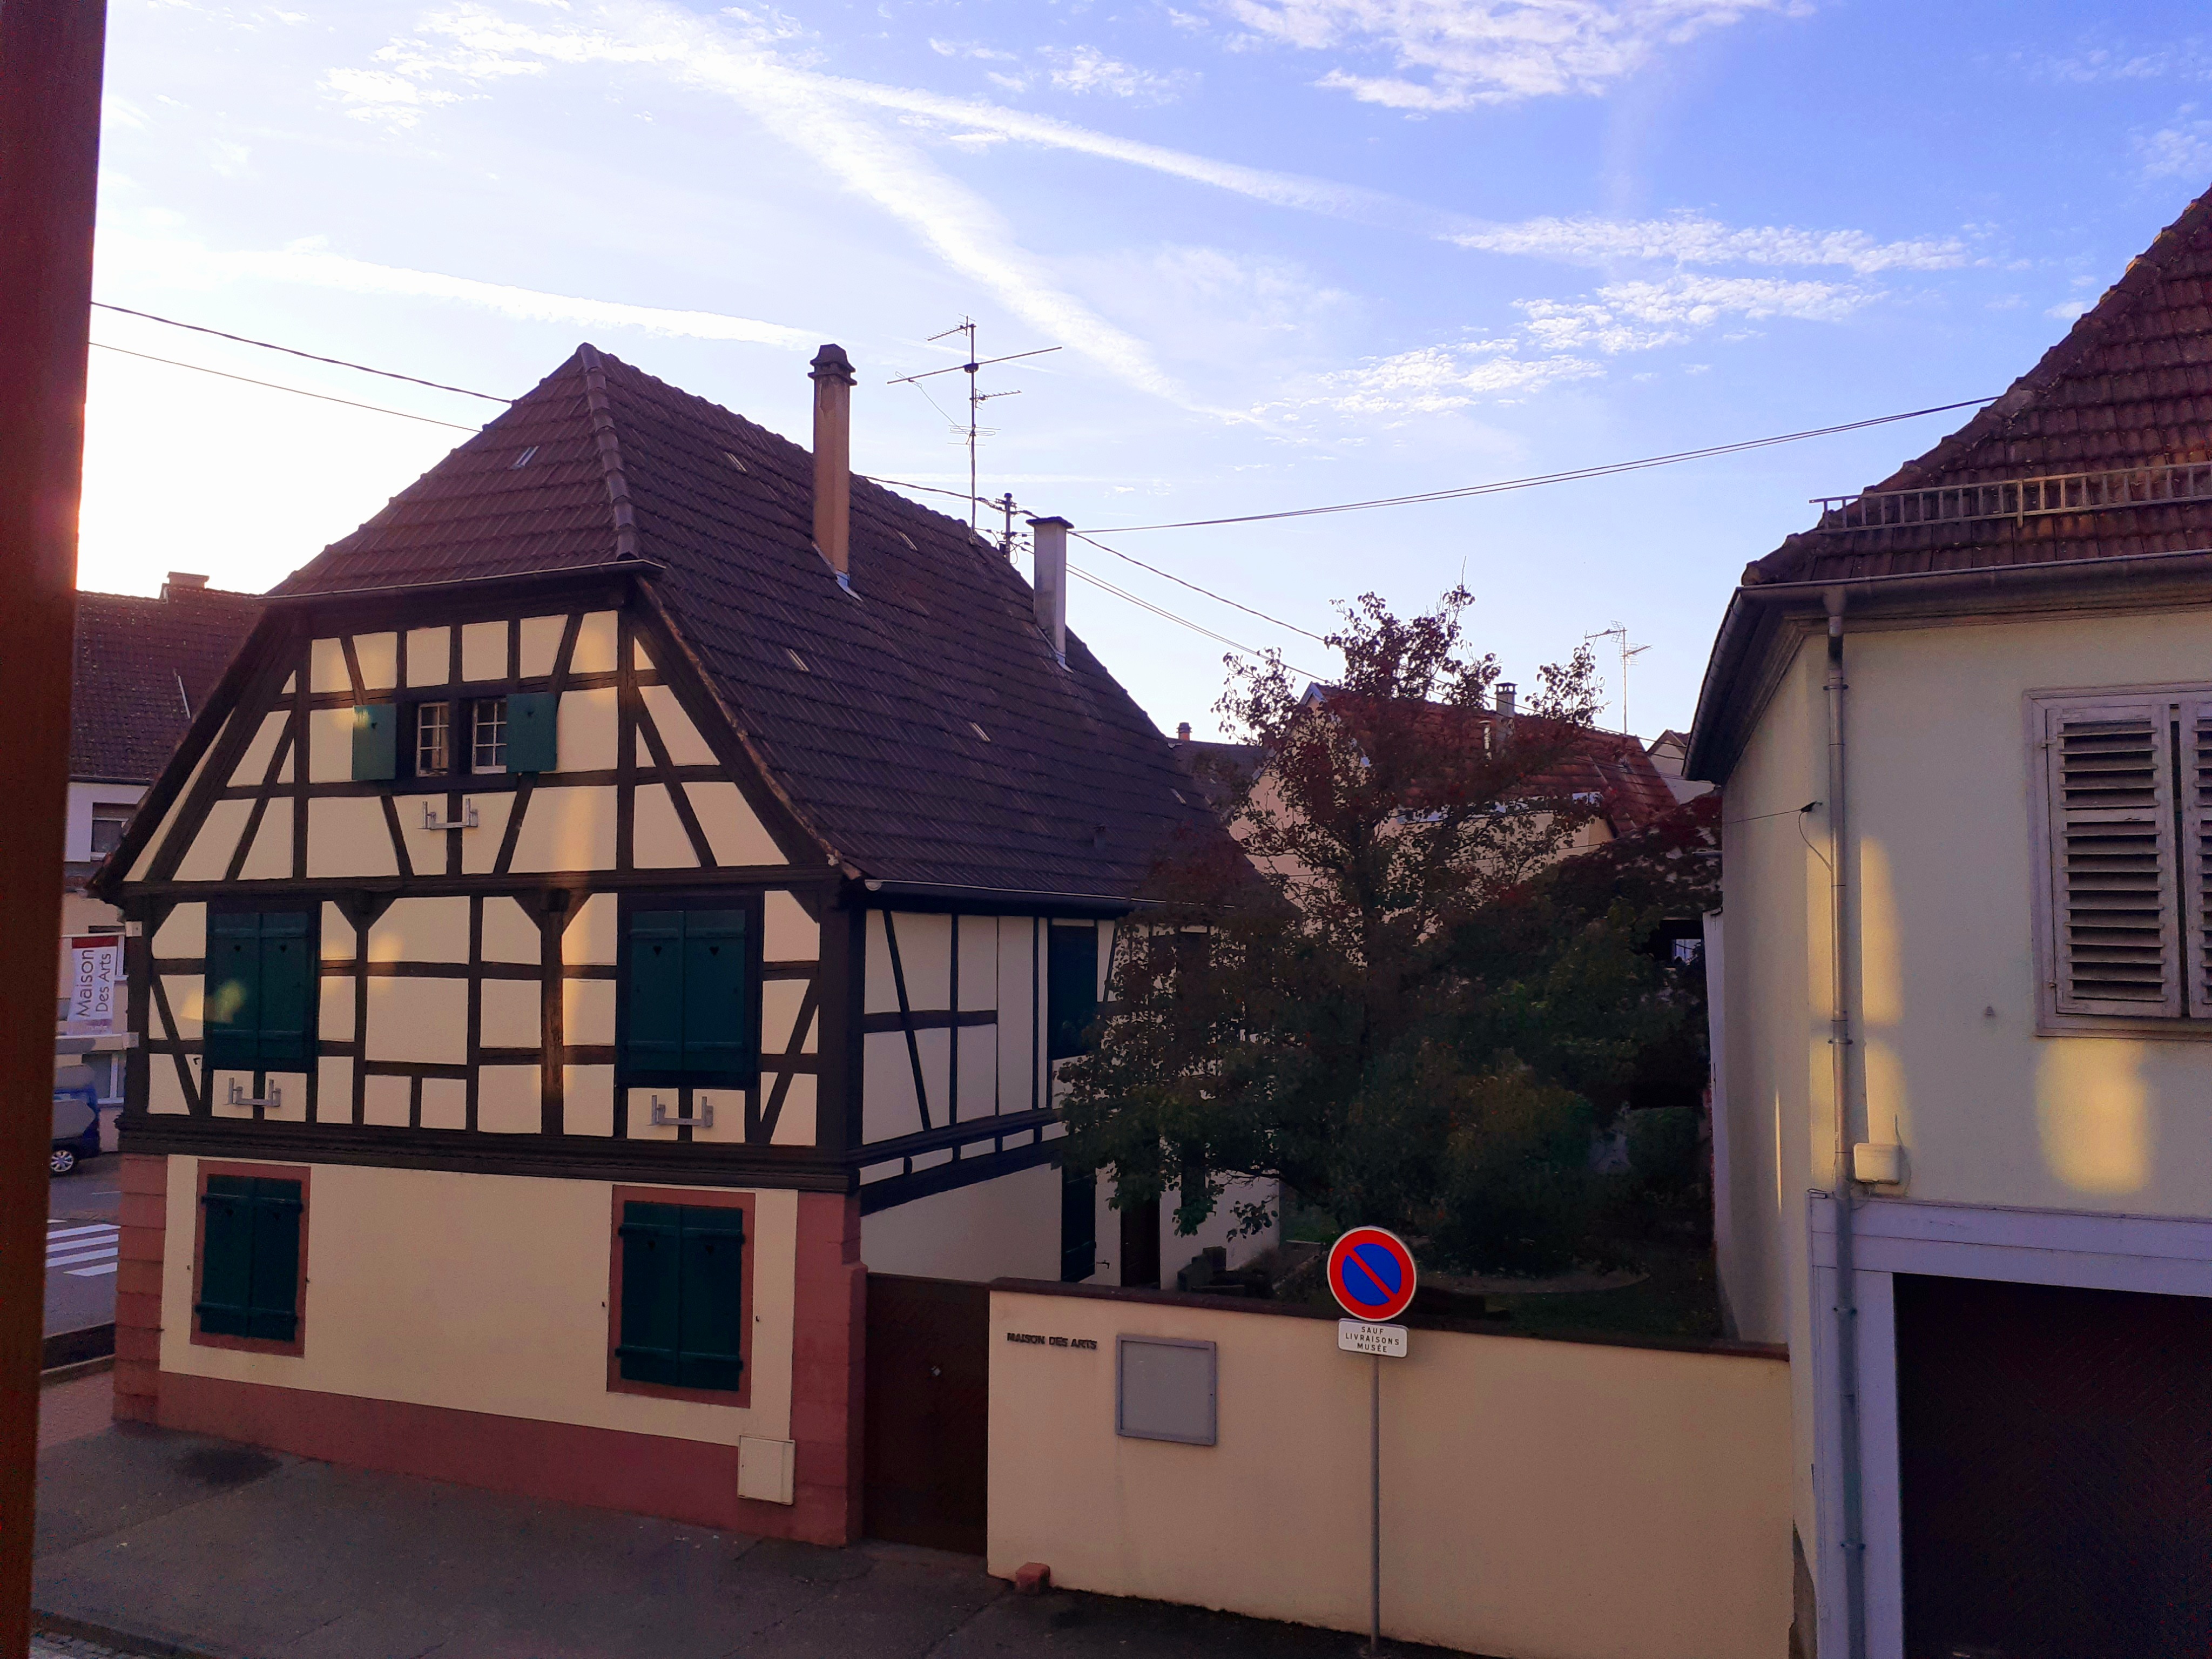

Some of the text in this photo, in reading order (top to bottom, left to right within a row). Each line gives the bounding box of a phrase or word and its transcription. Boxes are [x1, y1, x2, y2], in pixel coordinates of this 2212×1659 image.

[98, 954, 111, 982] Arts
[76, 949, 95, 1017] Maison
[96, 987, 109, 1011] Des
[1361, 1326, 1384, 1334] SAUF
[1007, 1333, 1097, 1350] MAISON DES ARTS
[1346, 1333, 1399, 1345] LIVRAISONS
[1357, 1343, 1387, 1352] MUSÉE
